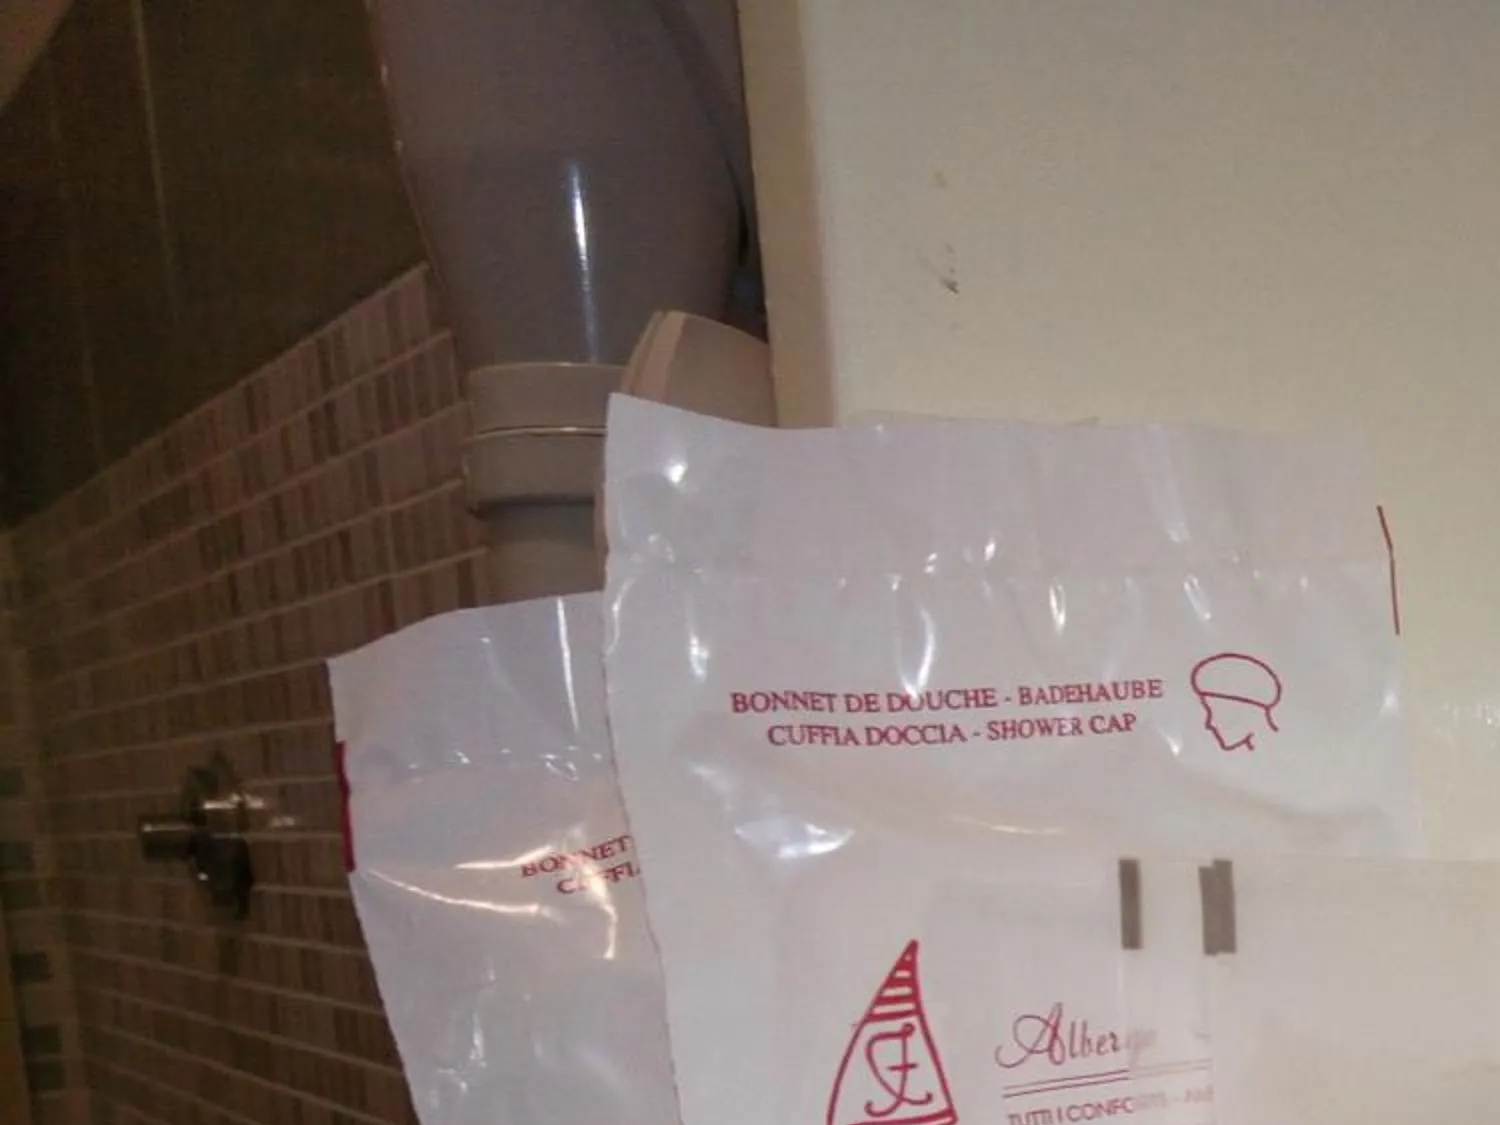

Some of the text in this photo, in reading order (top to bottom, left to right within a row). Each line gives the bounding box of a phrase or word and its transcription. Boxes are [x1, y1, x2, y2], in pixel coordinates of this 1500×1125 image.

[730, 691, 838, 713] BONNET
[844, 692, 881, 713] DE
[886, 688, 998, 713] DOUCHE
[1017, 679, 1164, 707] BADEHAUBE
[767, 724, 861, 746] CUFFIA
[866, 722, 968, 746] DOCCIA
[986, 716, 1085, 742] SHOWER
[1089, 712, 1137, 735] CAP
